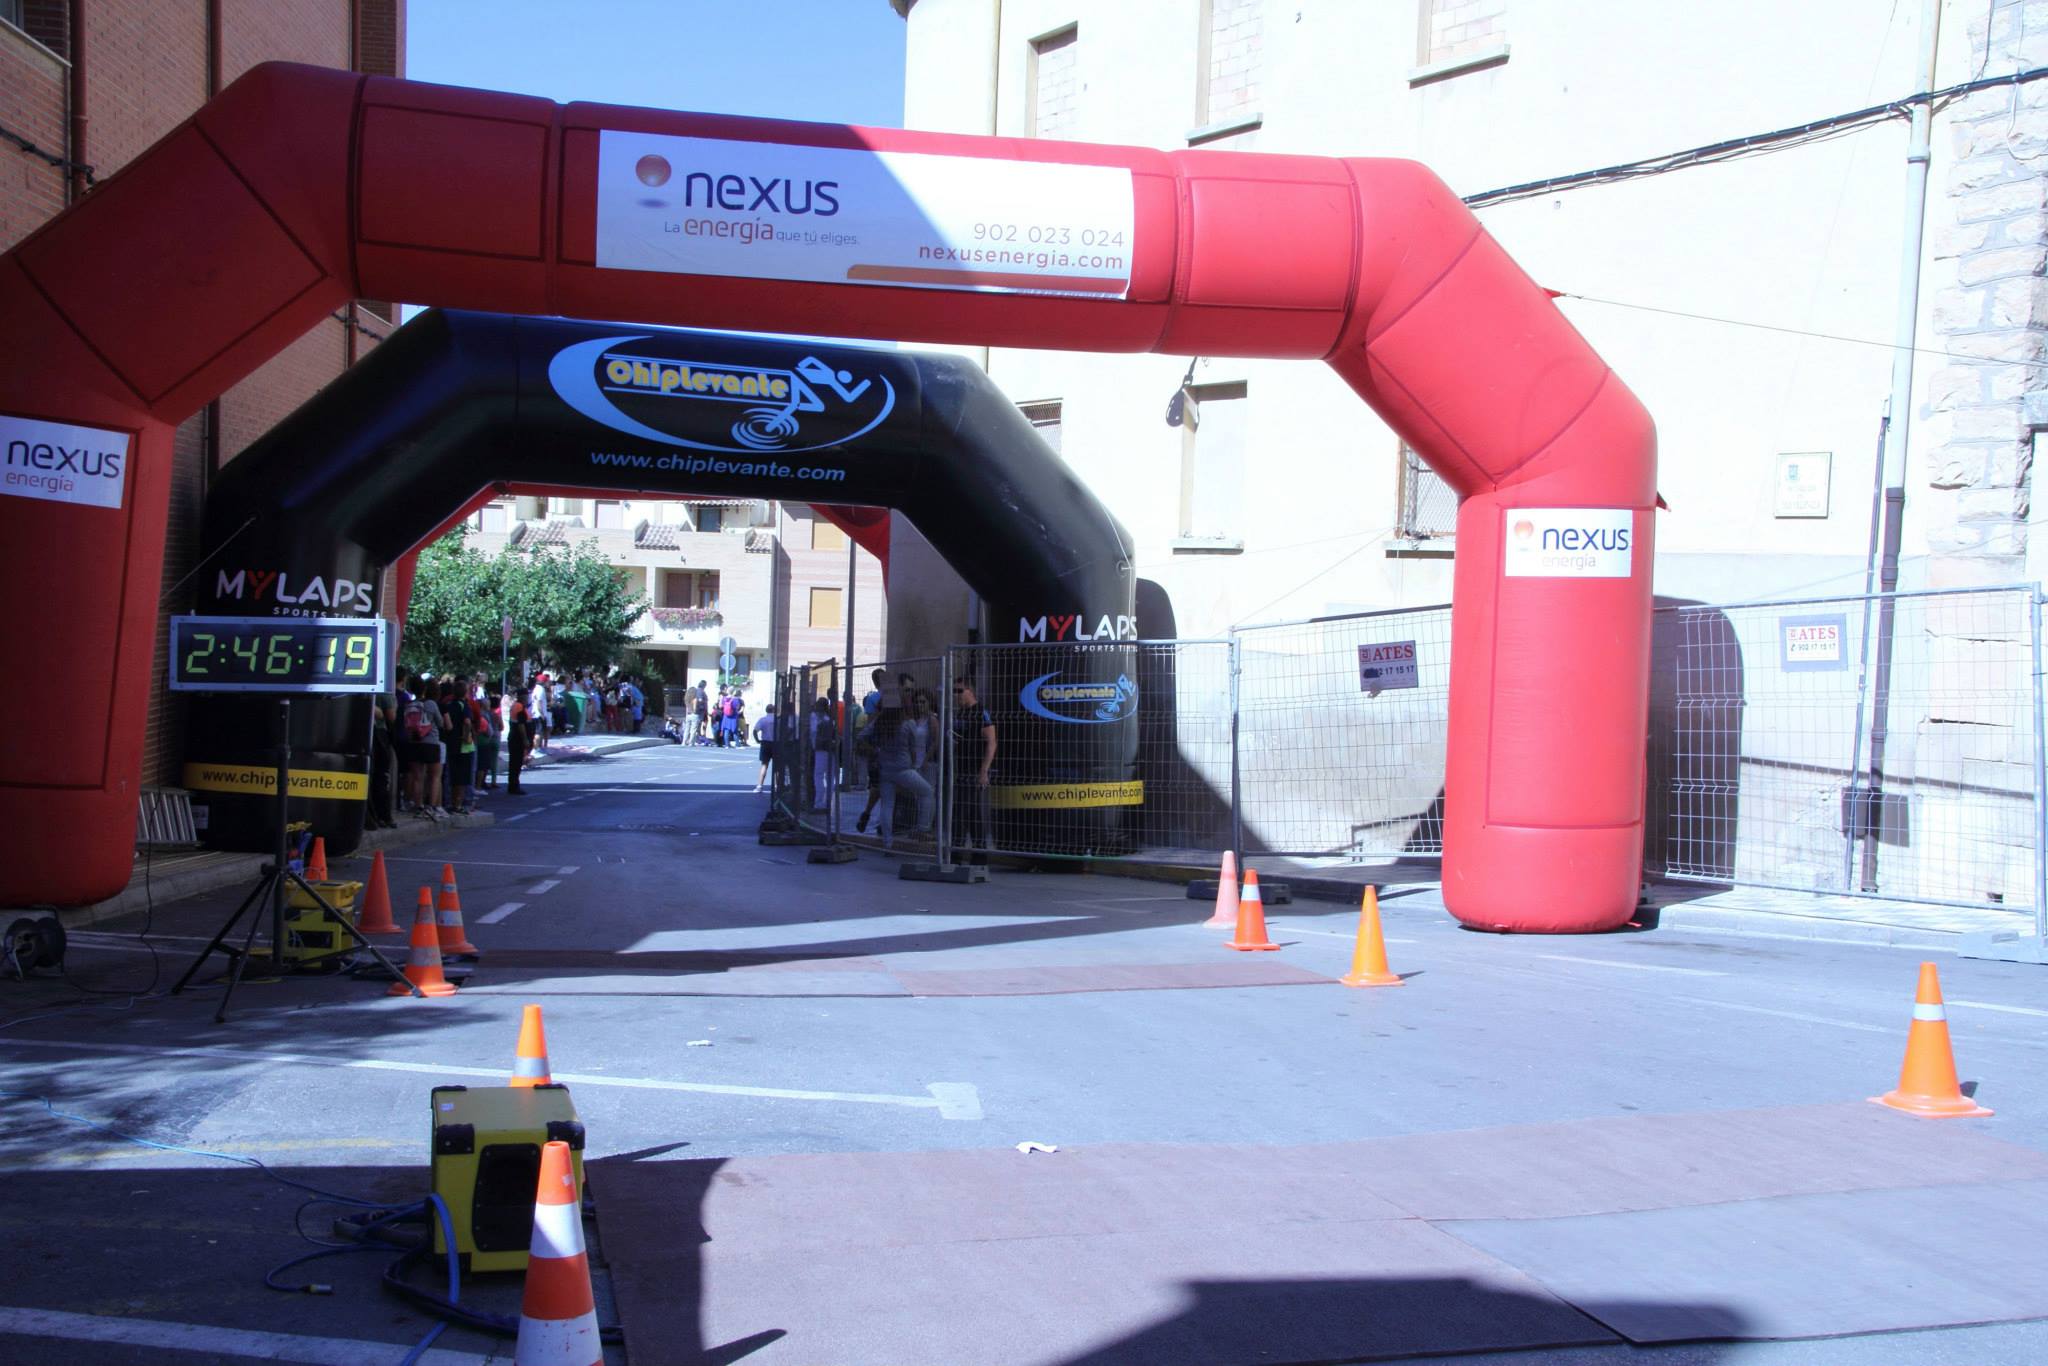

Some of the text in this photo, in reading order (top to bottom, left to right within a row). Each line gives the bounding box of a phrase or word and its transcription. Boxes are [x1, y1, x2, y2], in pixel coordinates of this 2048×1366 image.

[685, 172, 839, 217] nexus
[664, 221, 681, 233] La
[685, 217, 773, 244] energía
[776, 230, 801, 242] que
[804, 231, 817, 242] tú
[974, 223, 1124, 247] 902 023 024
[919, 245, 1123, 269] nexusenergia.com
[607, 359, 789, 399] Chiplevante
[8, 440, 121, 479] nexus
[590, 452, 846, 482] www.chiplevante.com
[6, 471, 74, 493] energía
[1543, 528, 1629, 551] nexus
[216, 568, 373, 613] MYLAPS
[273, 606, 327, 618] SPORTS
[1019, 614, 1138, 642] MYLAPS
[1799, 627, 1836, 640] ATES
[186, 634, 373, 676] 2:46:19
[1074, 644, 1115, 653] SPORTS
[1372, 644, 1414, 661] ATES
[202, 769, 358, 792] www.chipvante.com
